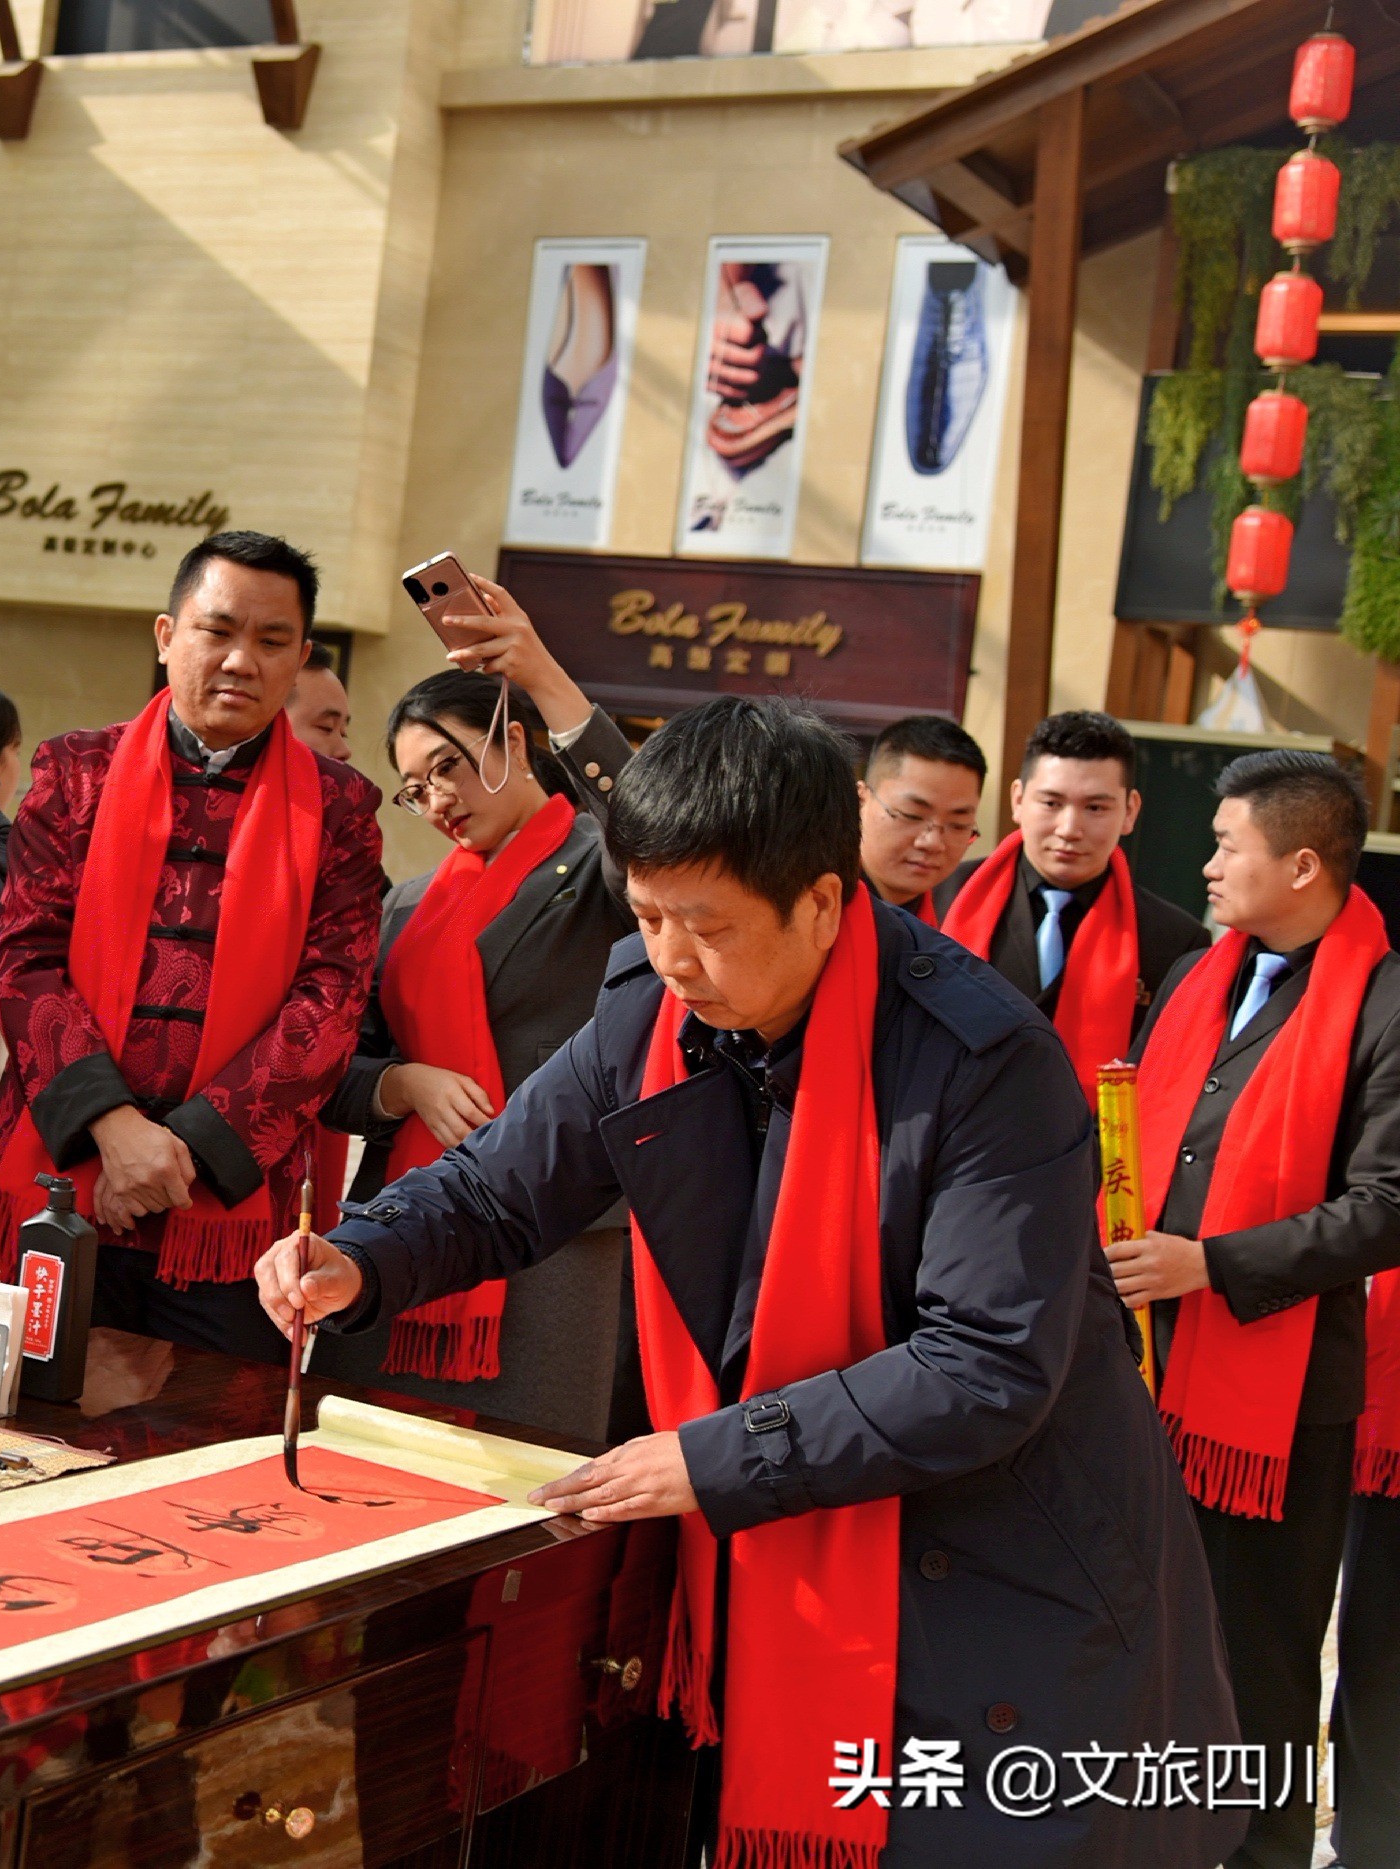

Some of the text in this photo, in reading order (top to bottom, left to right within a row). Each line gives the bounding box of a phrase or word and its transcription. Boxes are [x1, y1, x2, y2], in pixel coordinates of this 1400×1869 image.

[88, 482, 231, 537] Family
[608, 589, 844, 658] Bola Family
